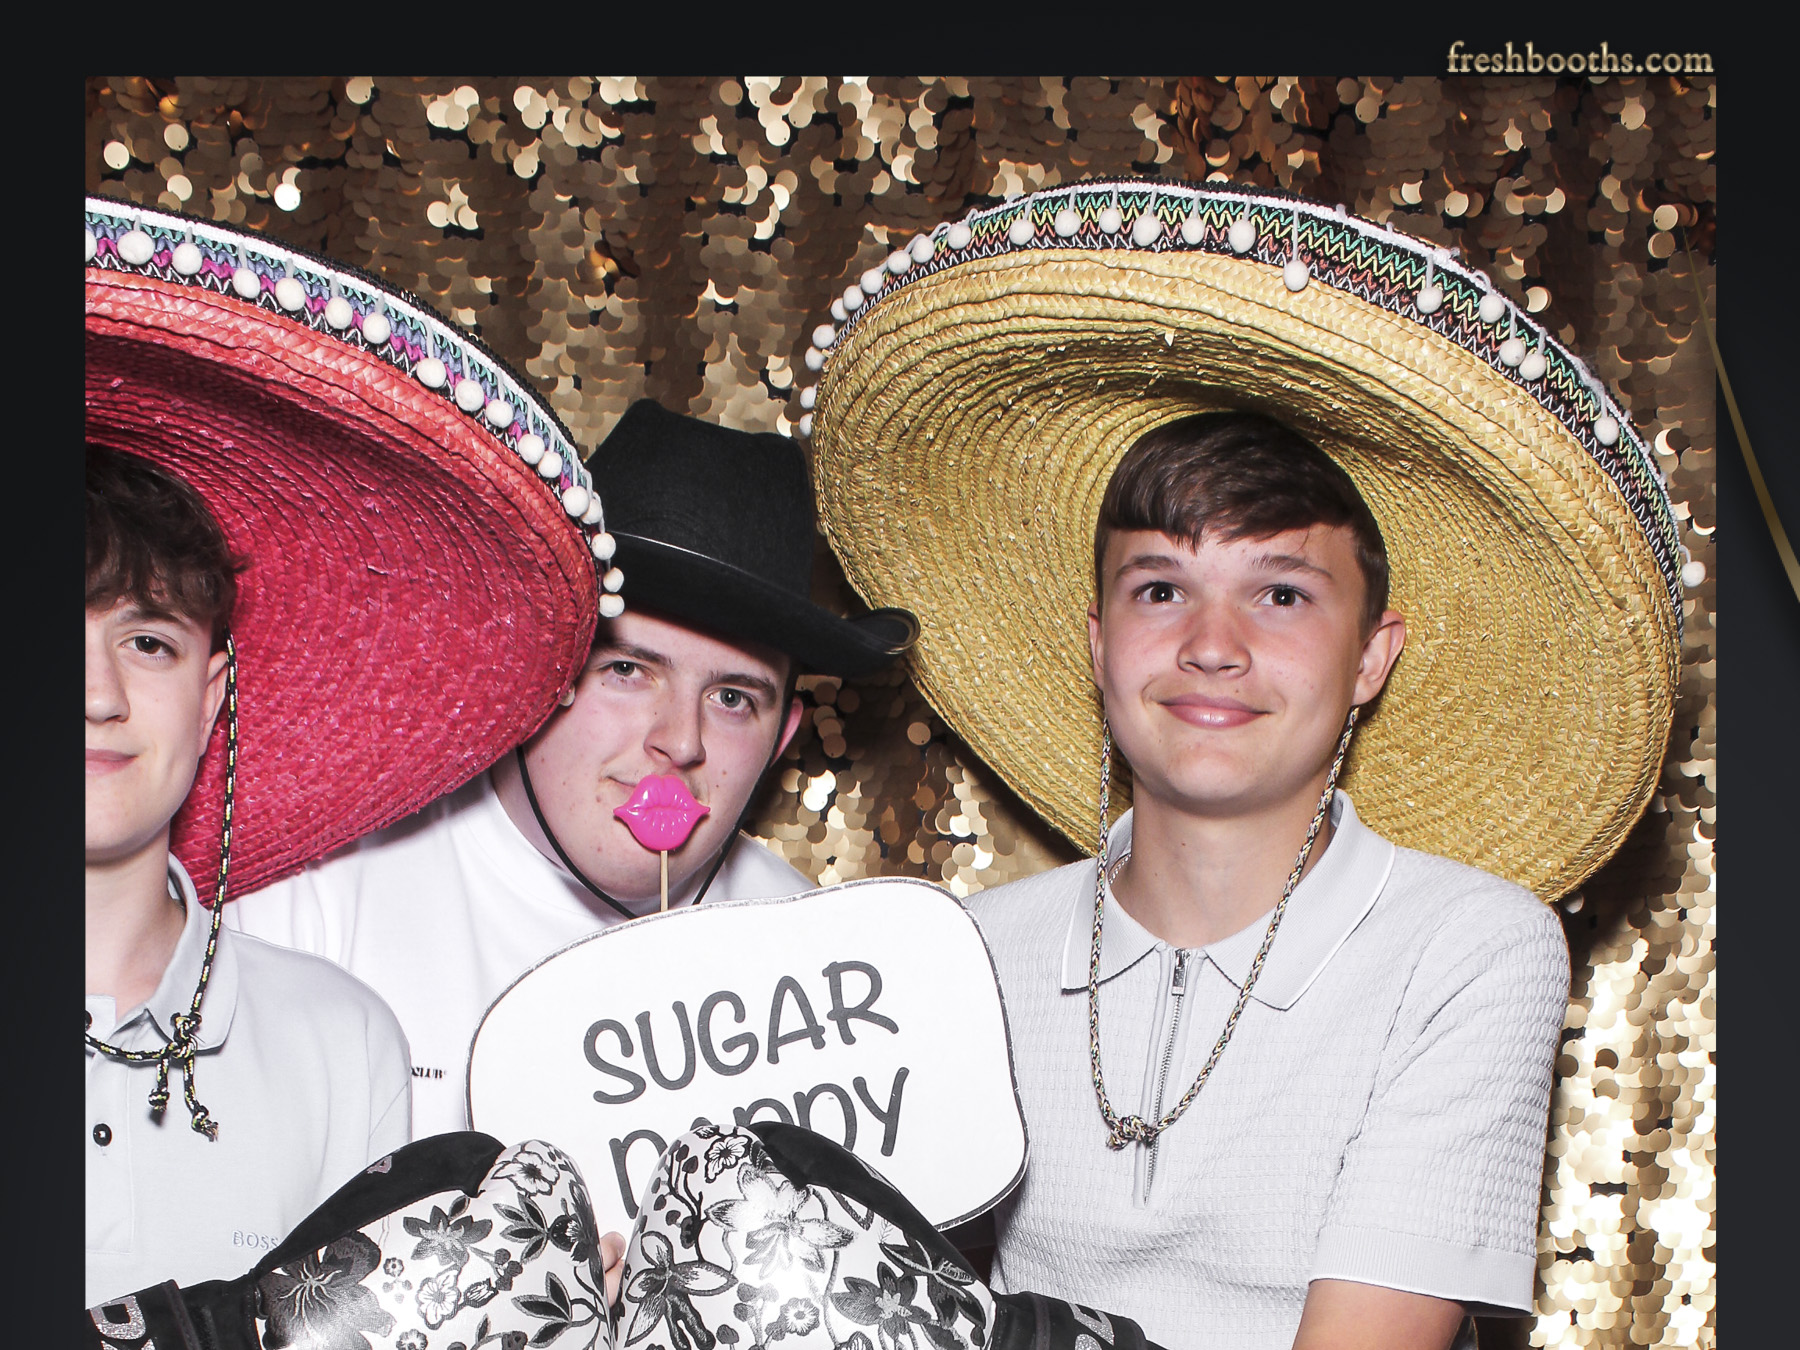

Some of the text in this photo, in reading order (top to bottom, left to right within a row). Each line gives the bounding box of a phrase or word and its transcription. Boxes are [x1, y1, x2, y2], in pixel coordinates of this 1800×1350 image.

[584, 960, 899, 1104] SUGAR
[609, 1067, 910, 1219] DDY
[233, 1230, 279, 1250] BOSS
